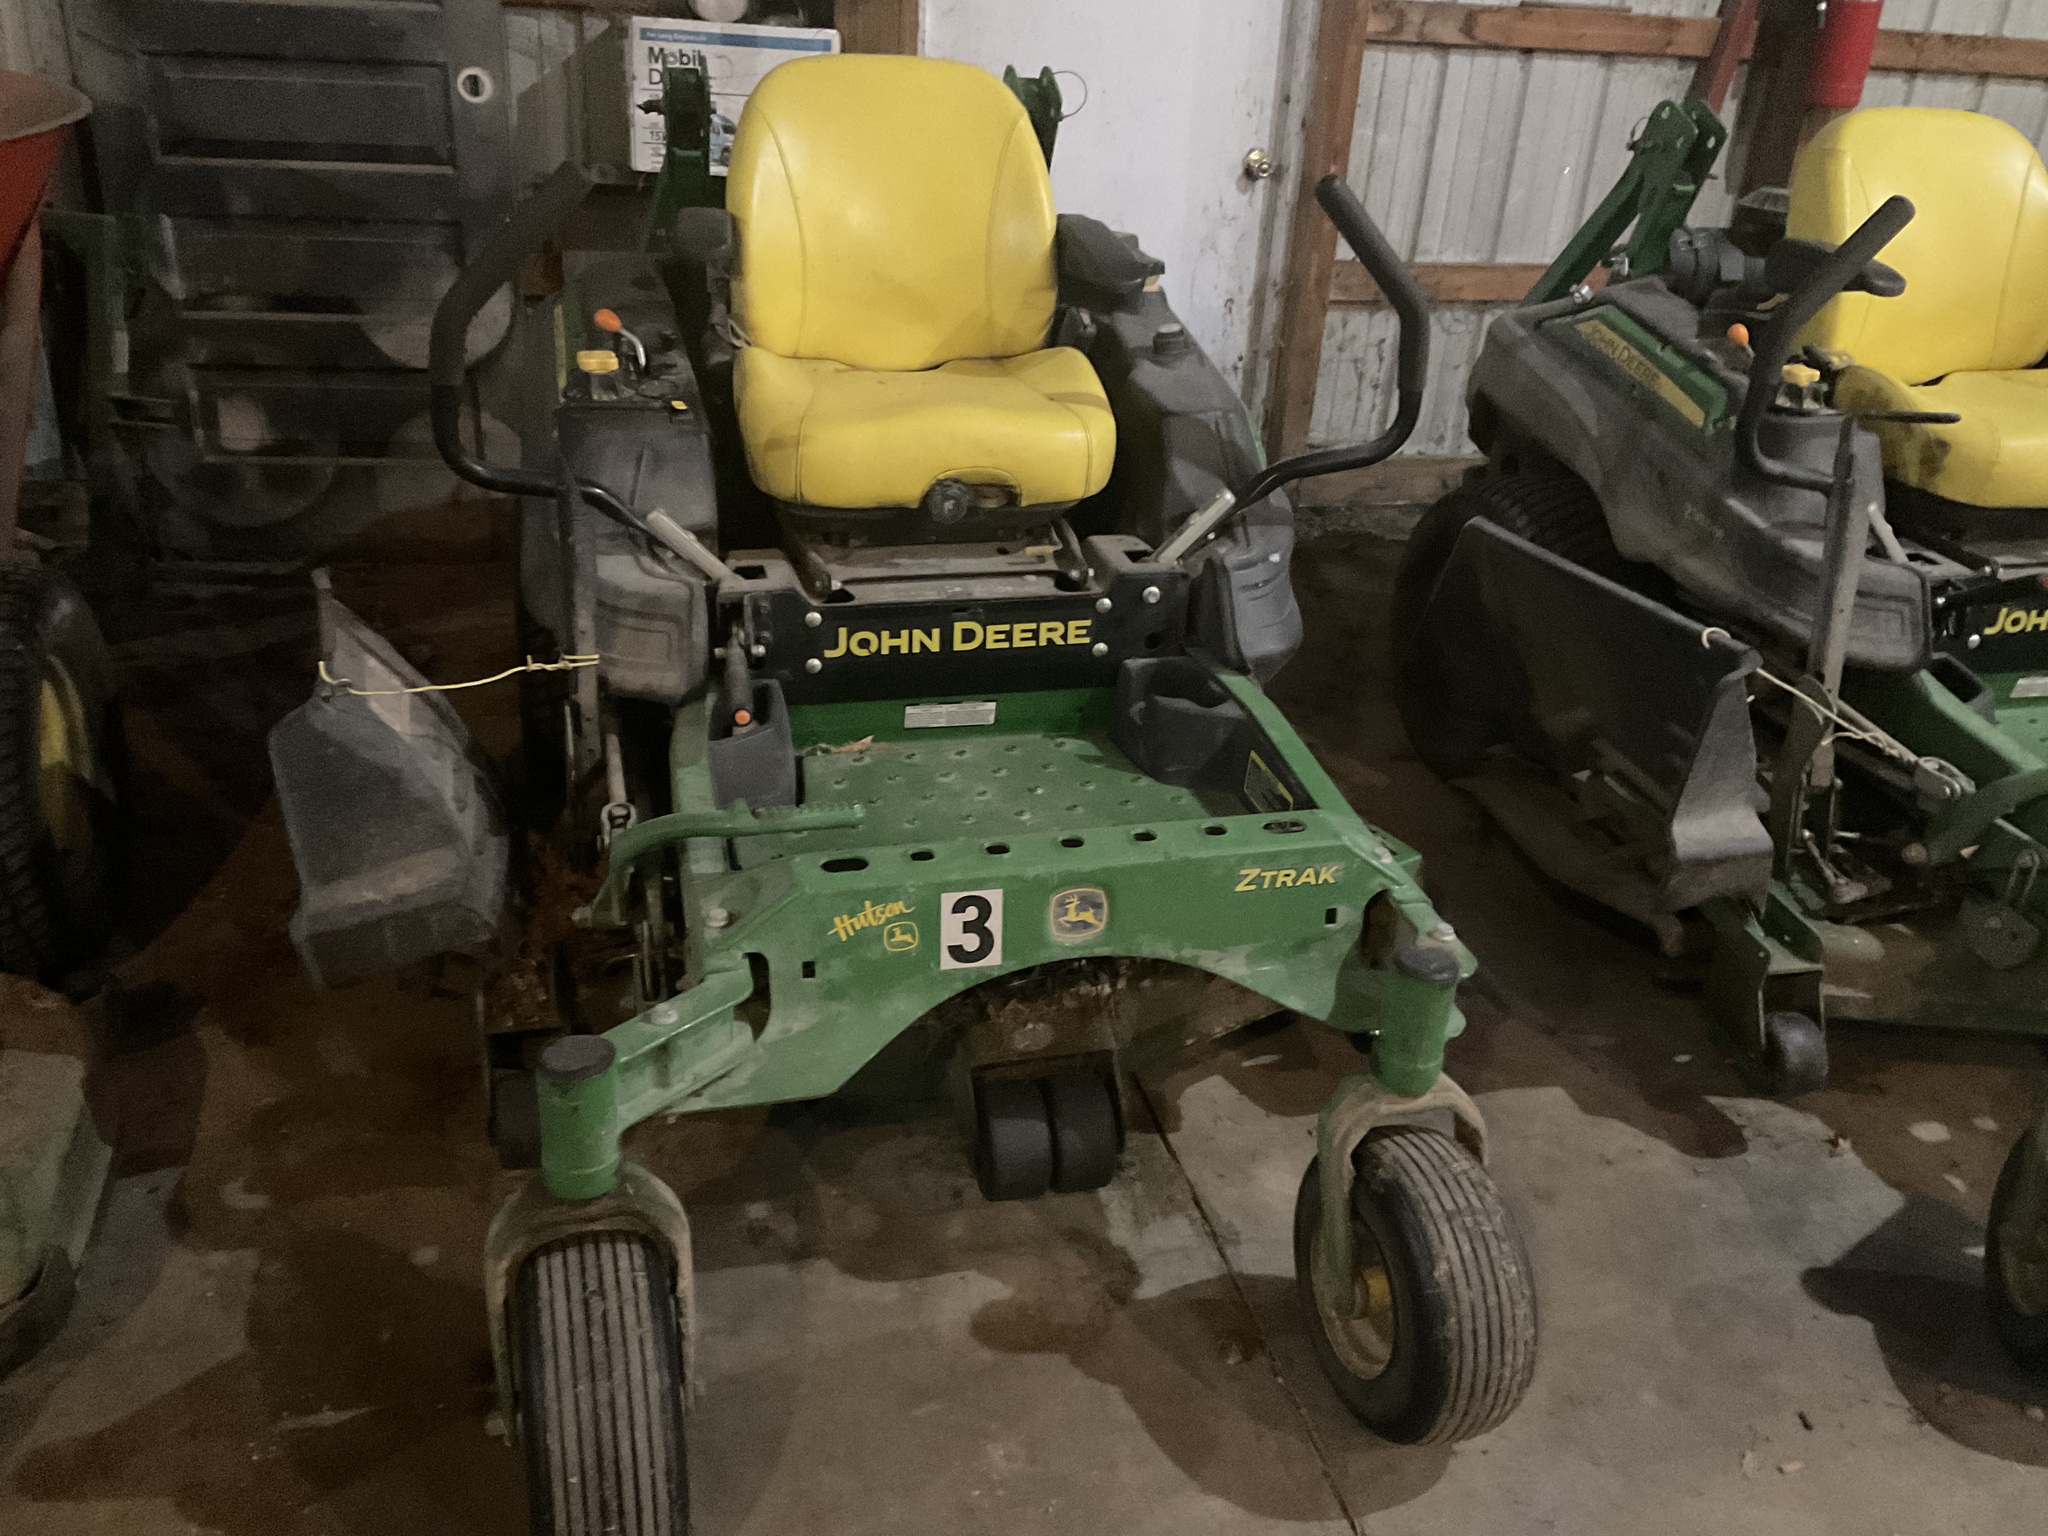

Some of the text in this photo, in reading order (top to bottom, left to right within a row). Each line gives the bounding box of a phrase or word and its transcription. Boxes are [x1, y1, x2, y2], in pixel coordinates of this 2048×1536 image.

[824, 619, 1092, 658] JOHN DEERE
[1234, 865, 1340, 892] ZTRAK
[827, 899, 915, 942] Hutson
[947, 895, 995, 964] 3
